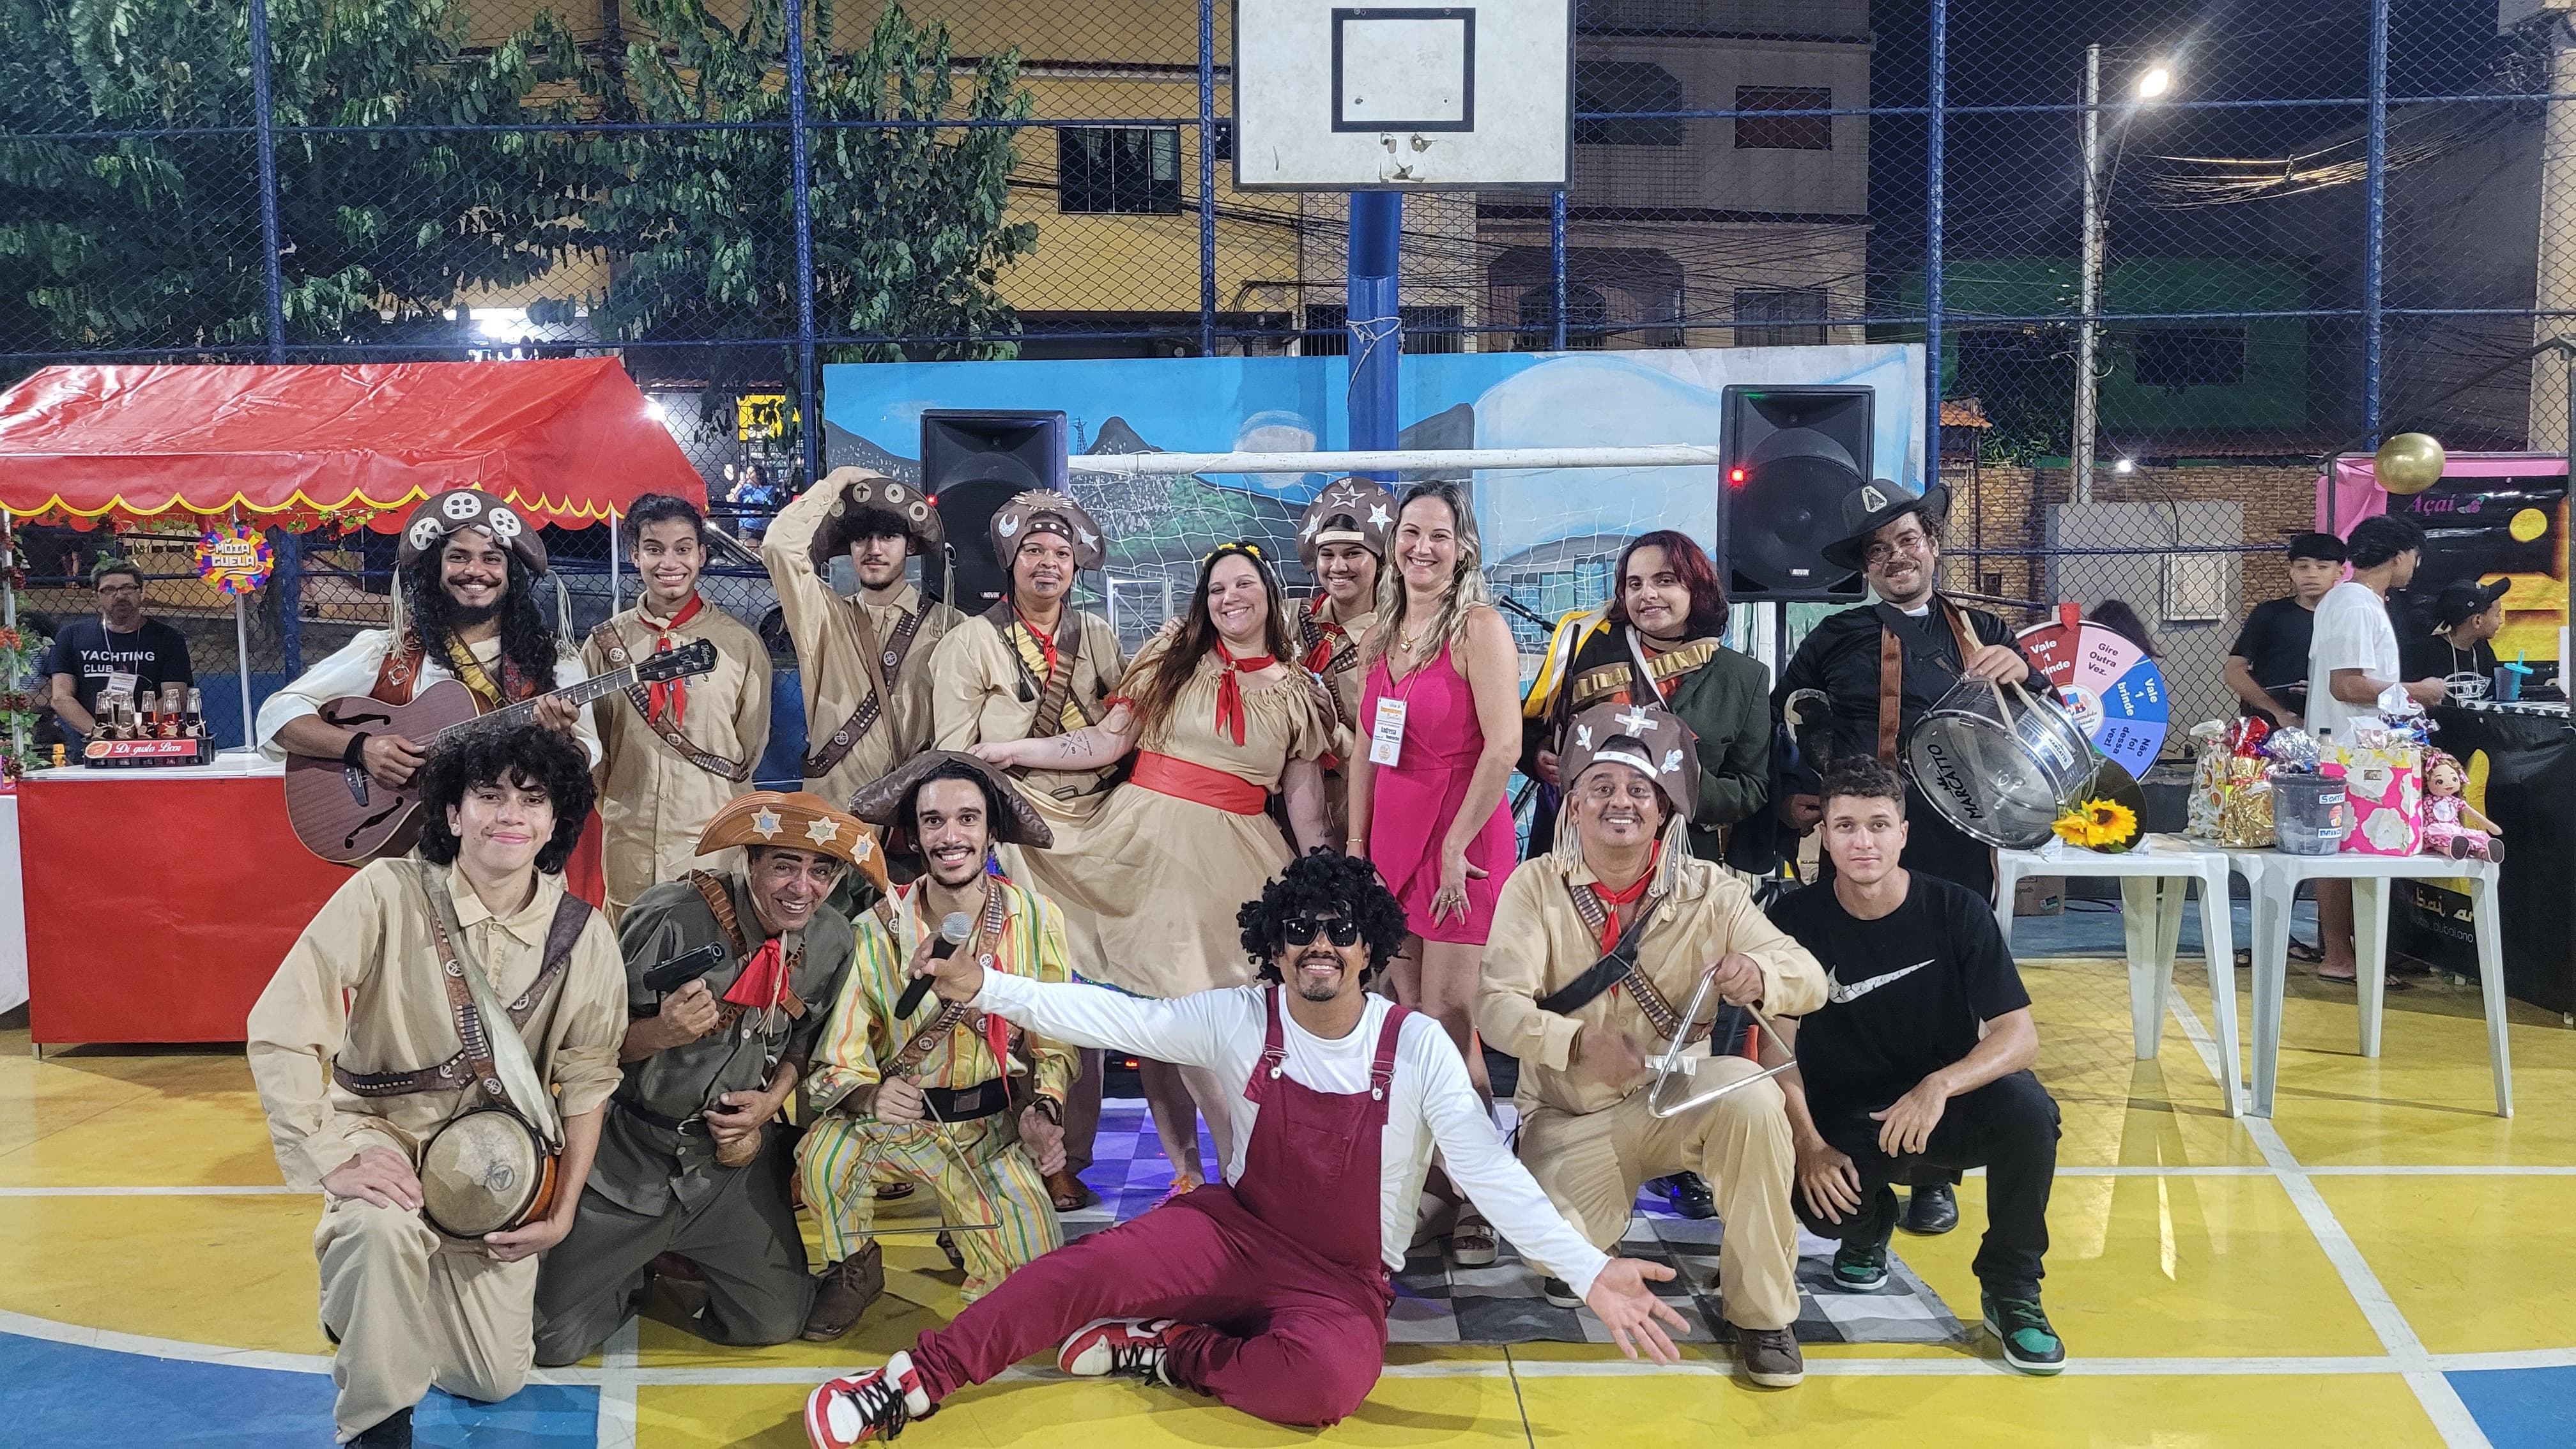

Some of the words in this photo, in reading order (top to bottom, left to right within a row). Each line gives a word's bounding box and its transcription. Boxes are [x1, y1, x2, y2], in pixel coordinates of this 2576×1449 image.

[211, 556, 255, 567] GUELA
[2030, 640, 2057, 654] Vale
[2098, 643, 2119, 656] Gire
[80, 650, 155, 661] YACHTING
[2044, 653, 2051, 661] 1
[2089, 651, 2117, 668] Outra
[84, 664, 114, 673] CLUB
[2040, 659, 2071, 675] rinde
[2145, 677, 2158, 703] Vale
[2117, 682, 2134, 716] brinde
[114, 742, 130, 753] Di
[130, 743, 155, 755] gusta
[158, 742, 182, 752] Licor
[2113, 726, 2129, 755] dessa
[2137, 738, 2151, 757] Não
[2048, 738, 2067, 763] MARCATTO
[1928, 744, 1983, 819] MARCATTO
